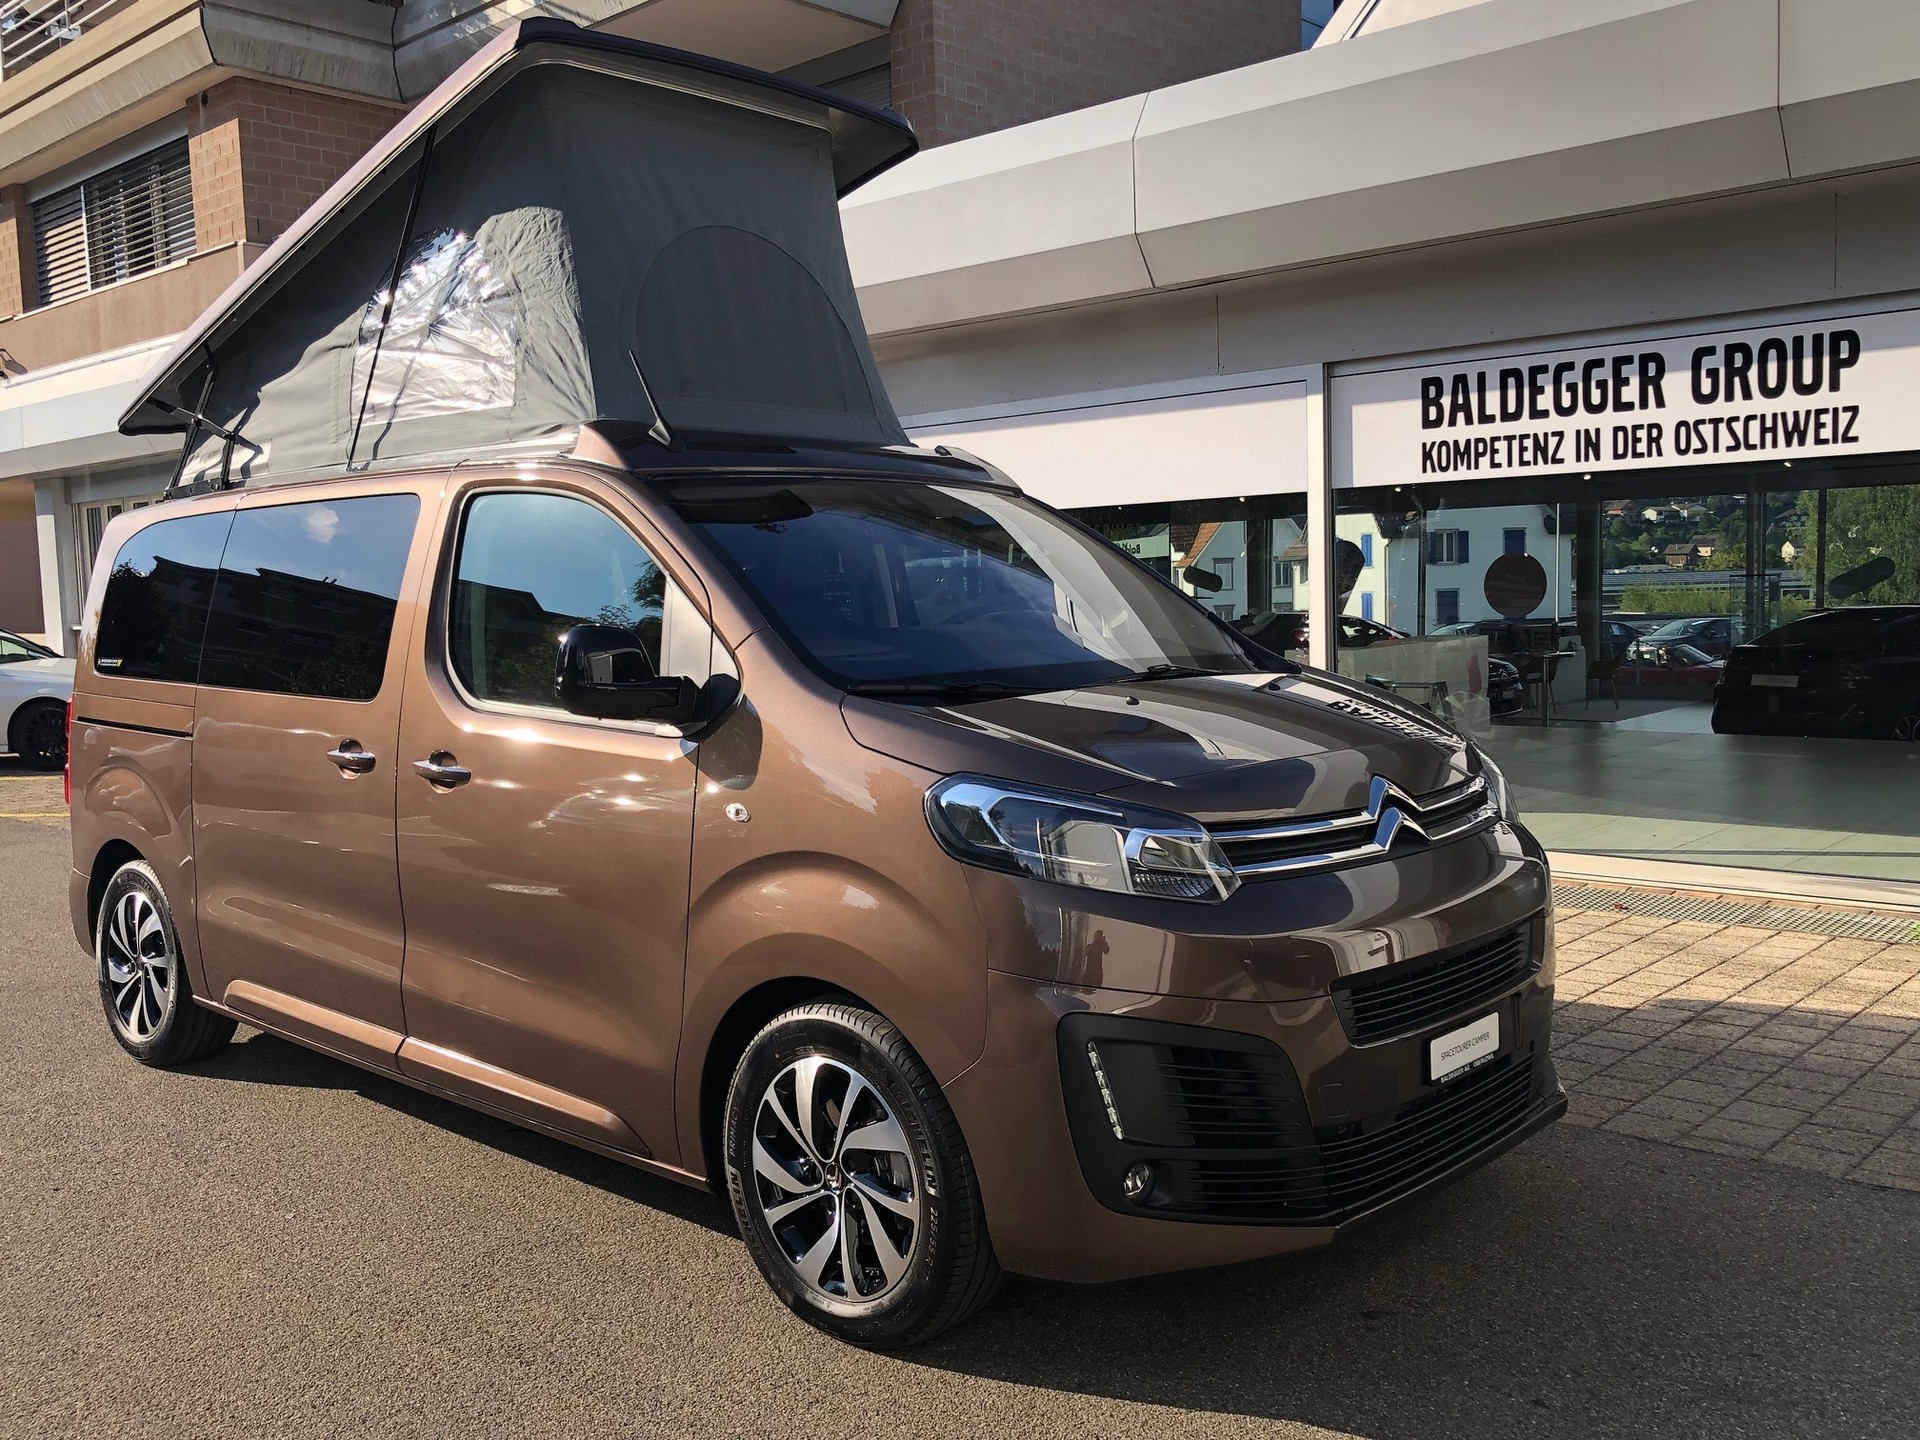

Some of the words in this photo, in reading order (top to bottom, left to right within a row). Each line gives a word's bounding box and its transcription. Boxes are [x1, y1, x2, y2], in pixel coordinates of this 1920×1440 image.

[1421, 351, 1666, 430] BALDEGGER
[1690, 329, 1861, 405] GROUP
[1421, 430, 1565, 474] KOMPETENZ
[1575, 428, 1601, 463] IN
[1612, 422, 1663, 460] DER
[1674, 405, 1860, 456] OSTSCHWEIZ
[1440, 1040, 1471, 1061] SPACETOURER
[1471, 1032, 1490, 1046] CAMPER
[728, 1106, 740, 1157] PRIMACY
